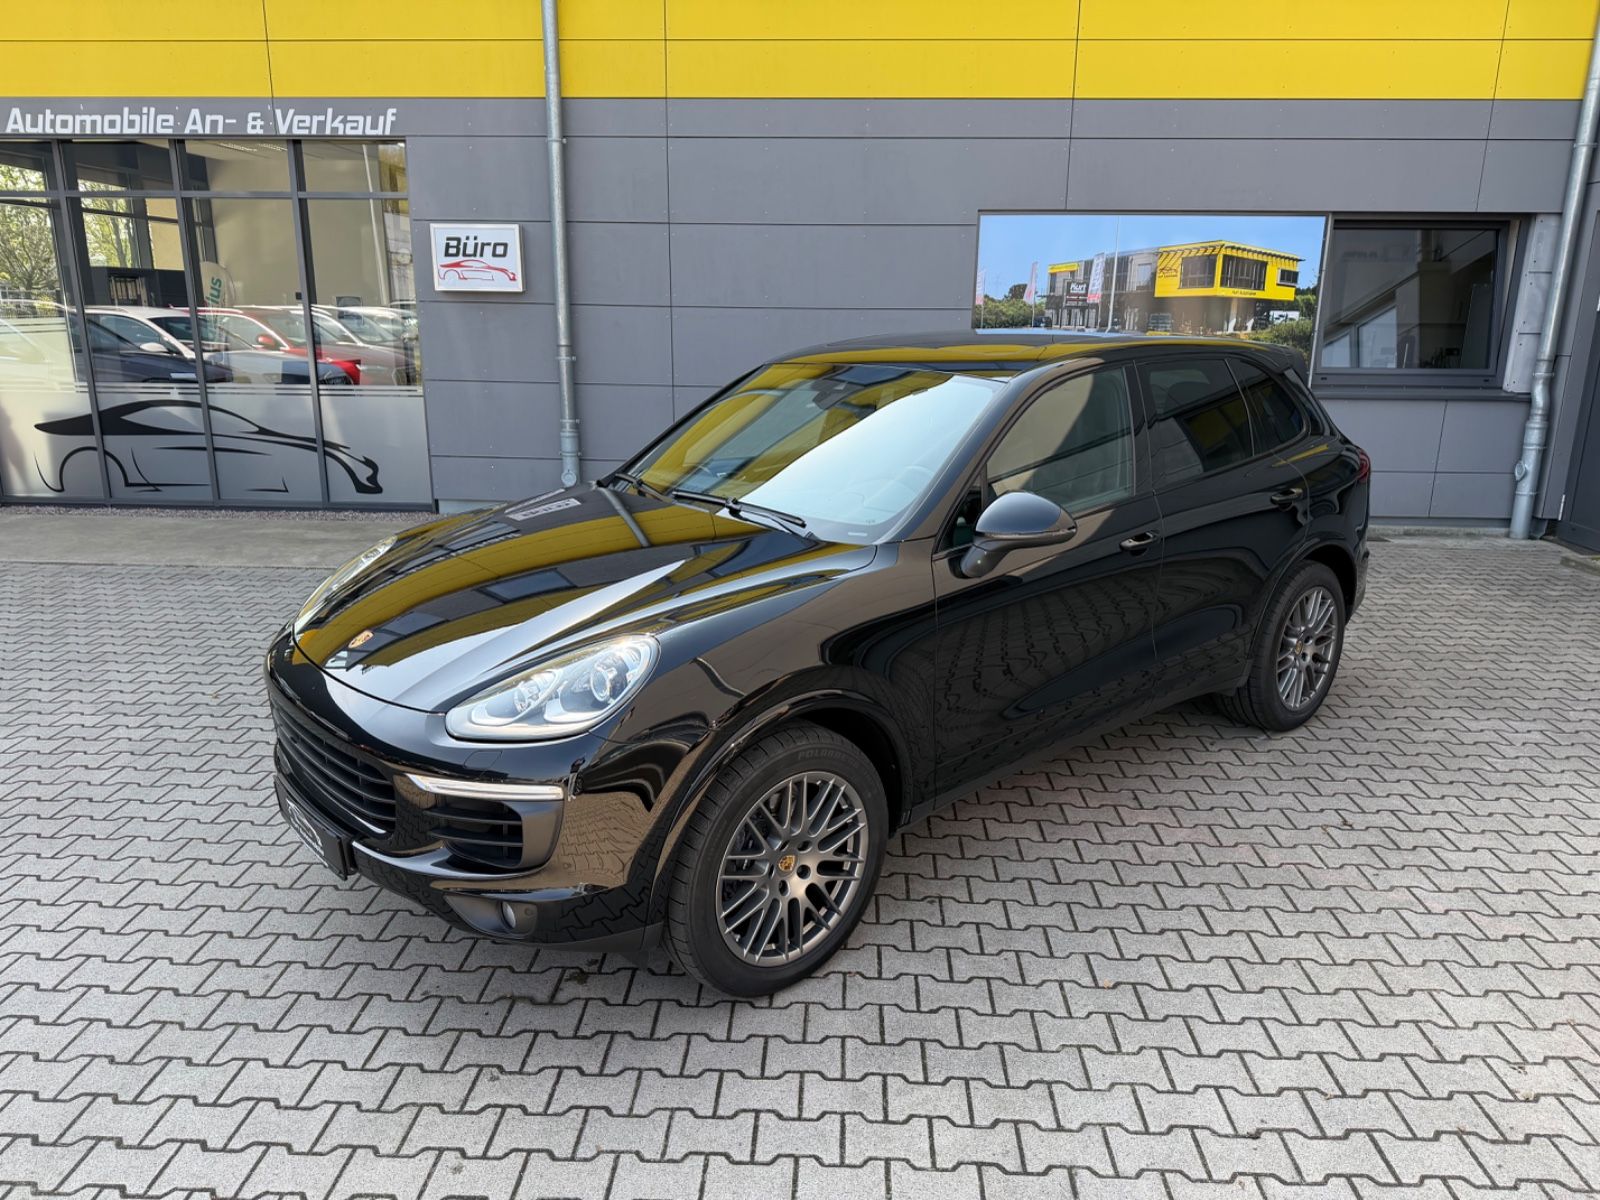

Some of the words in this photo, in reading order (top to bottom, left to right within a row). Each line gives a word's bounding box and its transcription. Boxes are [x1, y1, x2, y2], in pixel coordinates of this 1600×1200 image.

[5, 107, 174, 134] Automobile
[184, 108, 237, 134] An-
[247, 112, 264, 134] &
[275, 108, 397, 135] Verkauf
[444, 235, 508, 258] Büro
